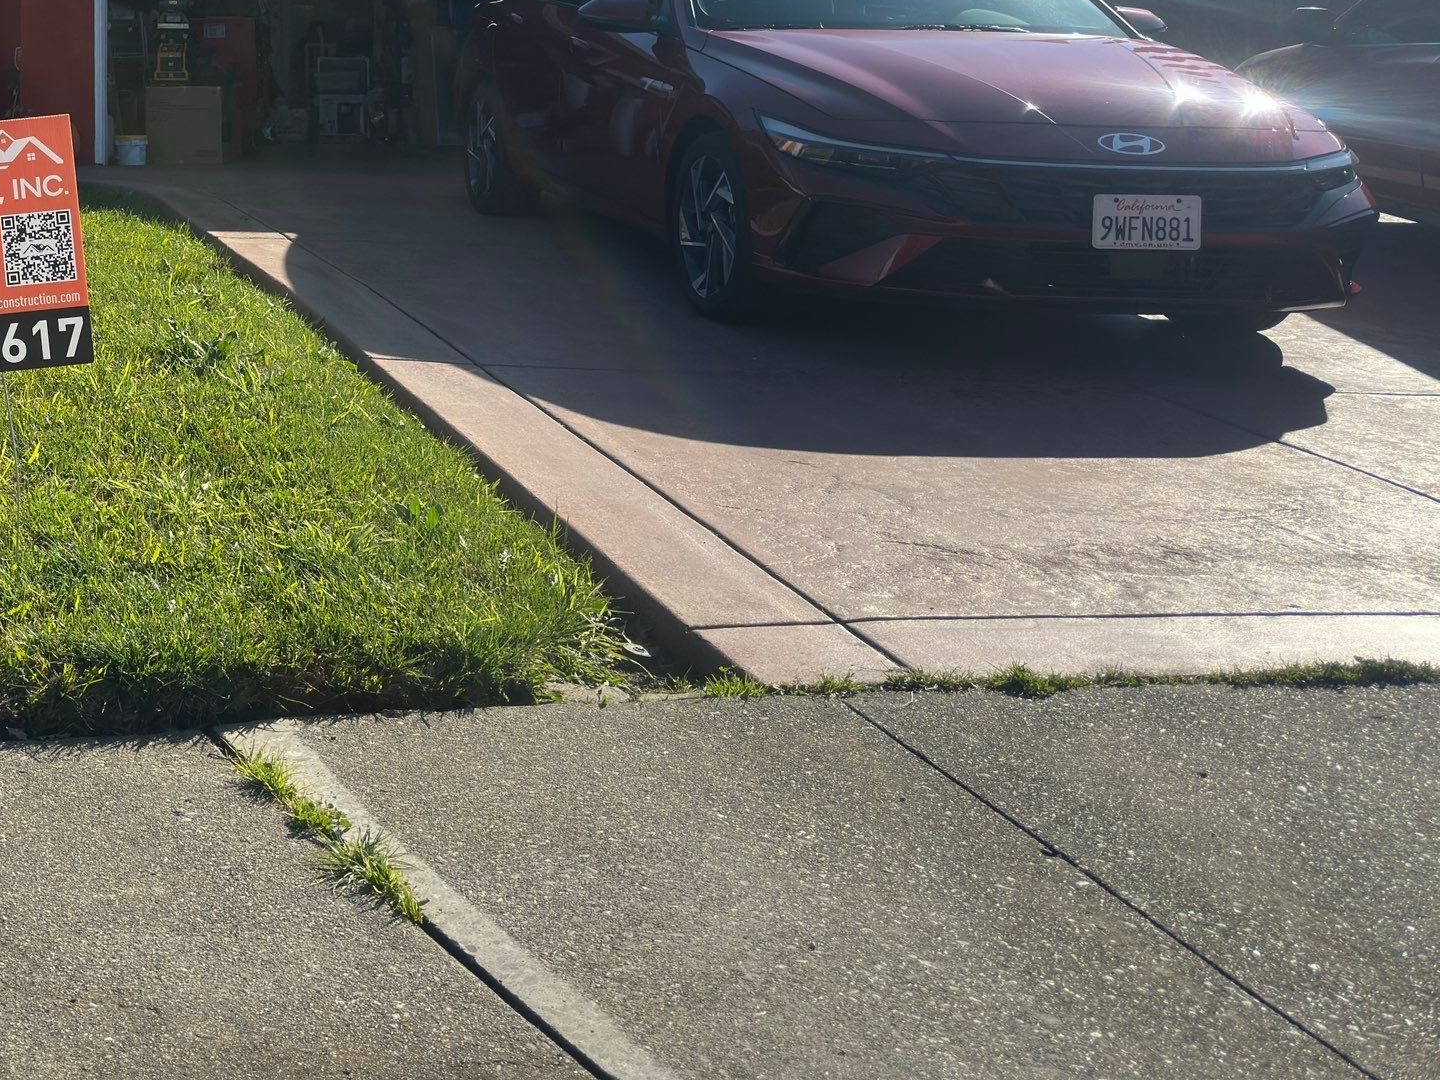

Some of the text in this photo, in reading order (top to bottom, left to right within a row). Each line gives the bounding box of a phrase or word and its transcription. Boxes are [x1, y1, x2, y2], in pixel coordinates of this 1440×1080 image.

[12, 175, 70, 200] INC.
[1116, 198, 1182, 214] California
[1100, 216, 1194, 242] 9WFN881
